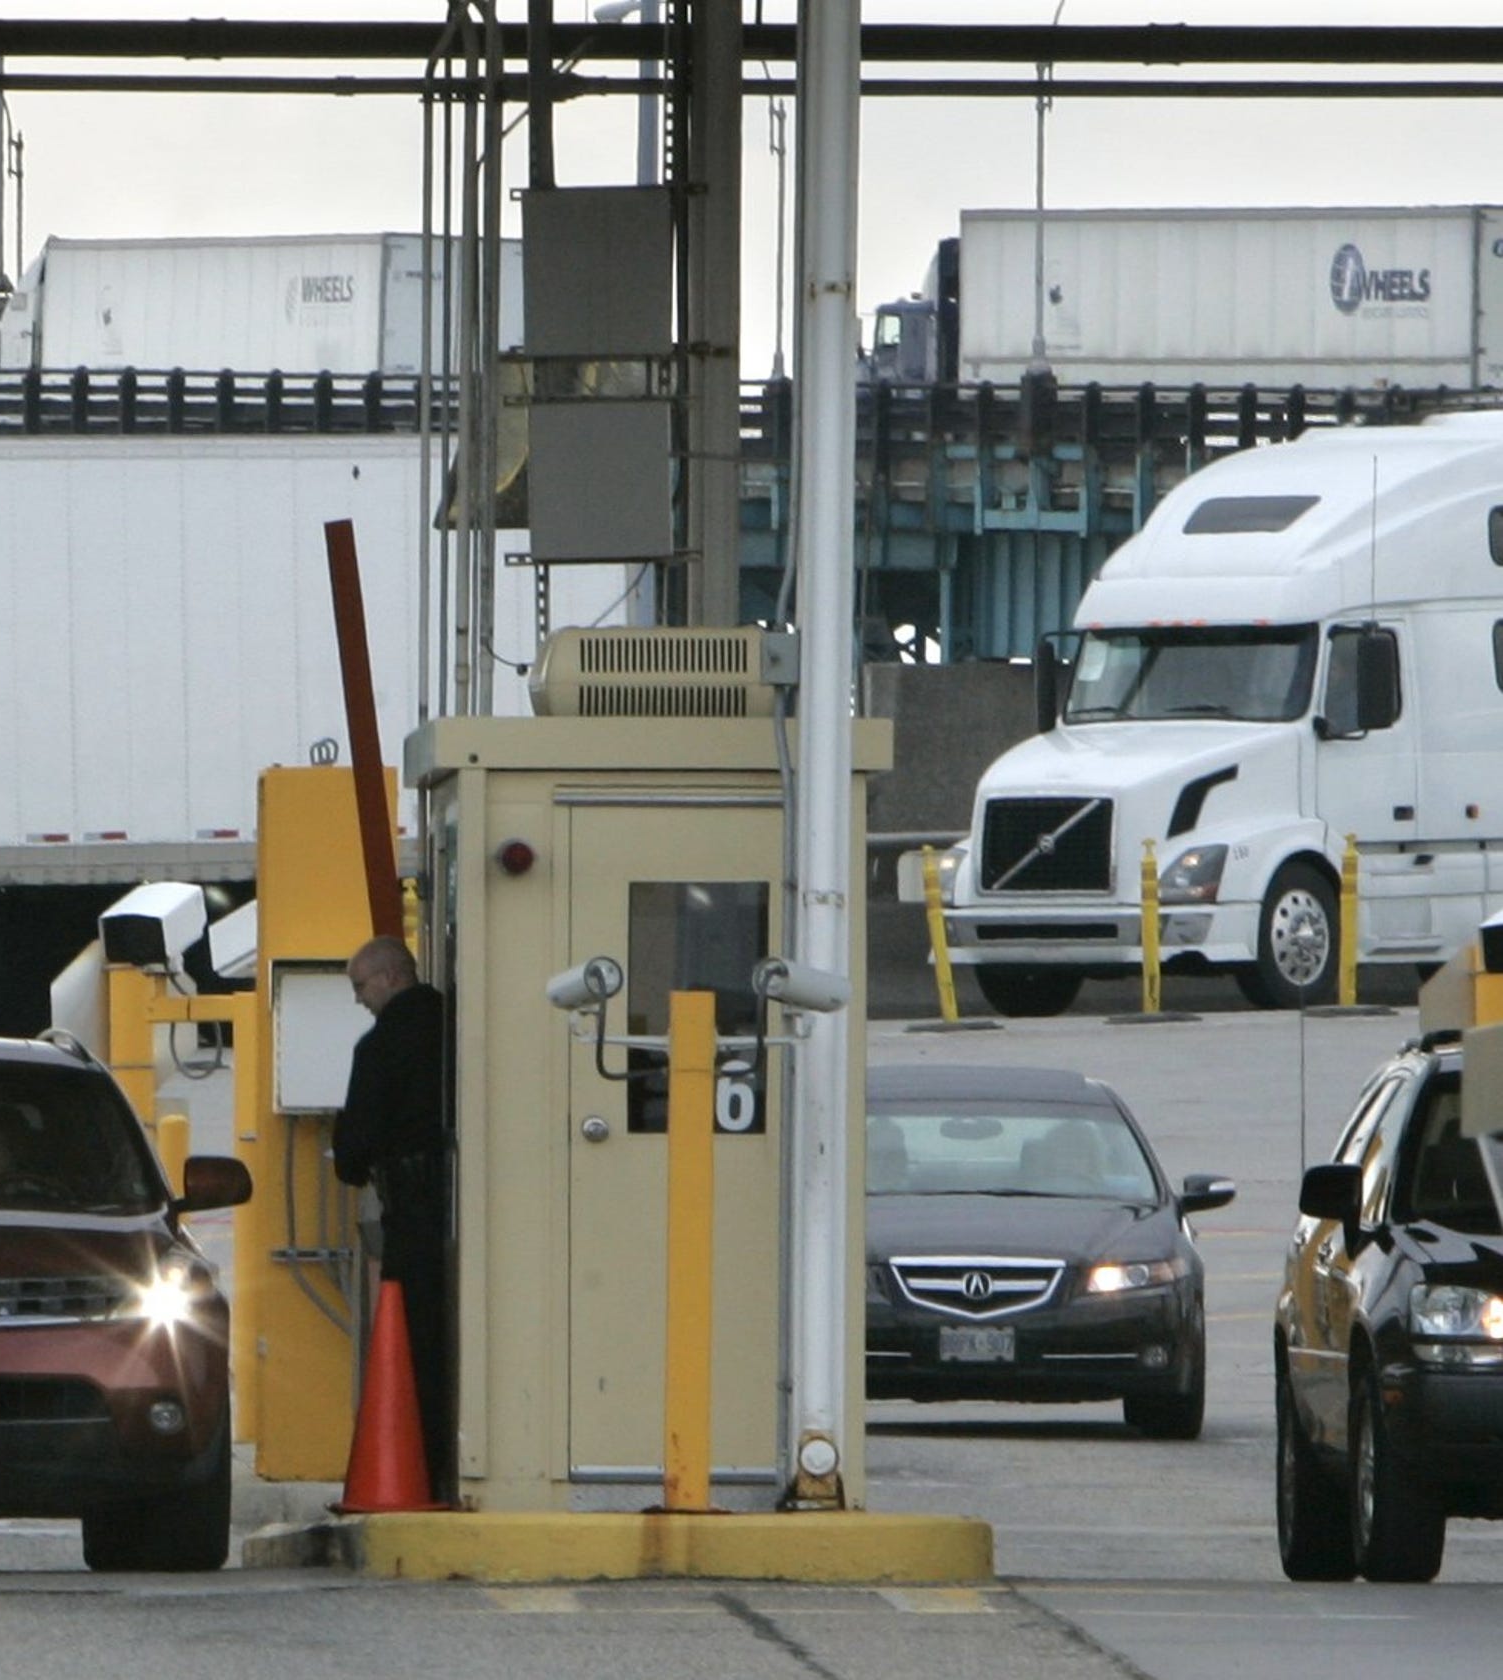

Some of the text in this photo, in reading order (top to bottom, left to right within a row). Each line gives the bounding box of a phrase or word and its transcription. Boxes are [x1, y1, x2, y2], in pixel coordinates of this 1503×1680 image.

[301, 275, 354, 303] WHEELS
[1361, 269, 1431, 302] WHEELS
[716, 1060, 755, 1132] 6
